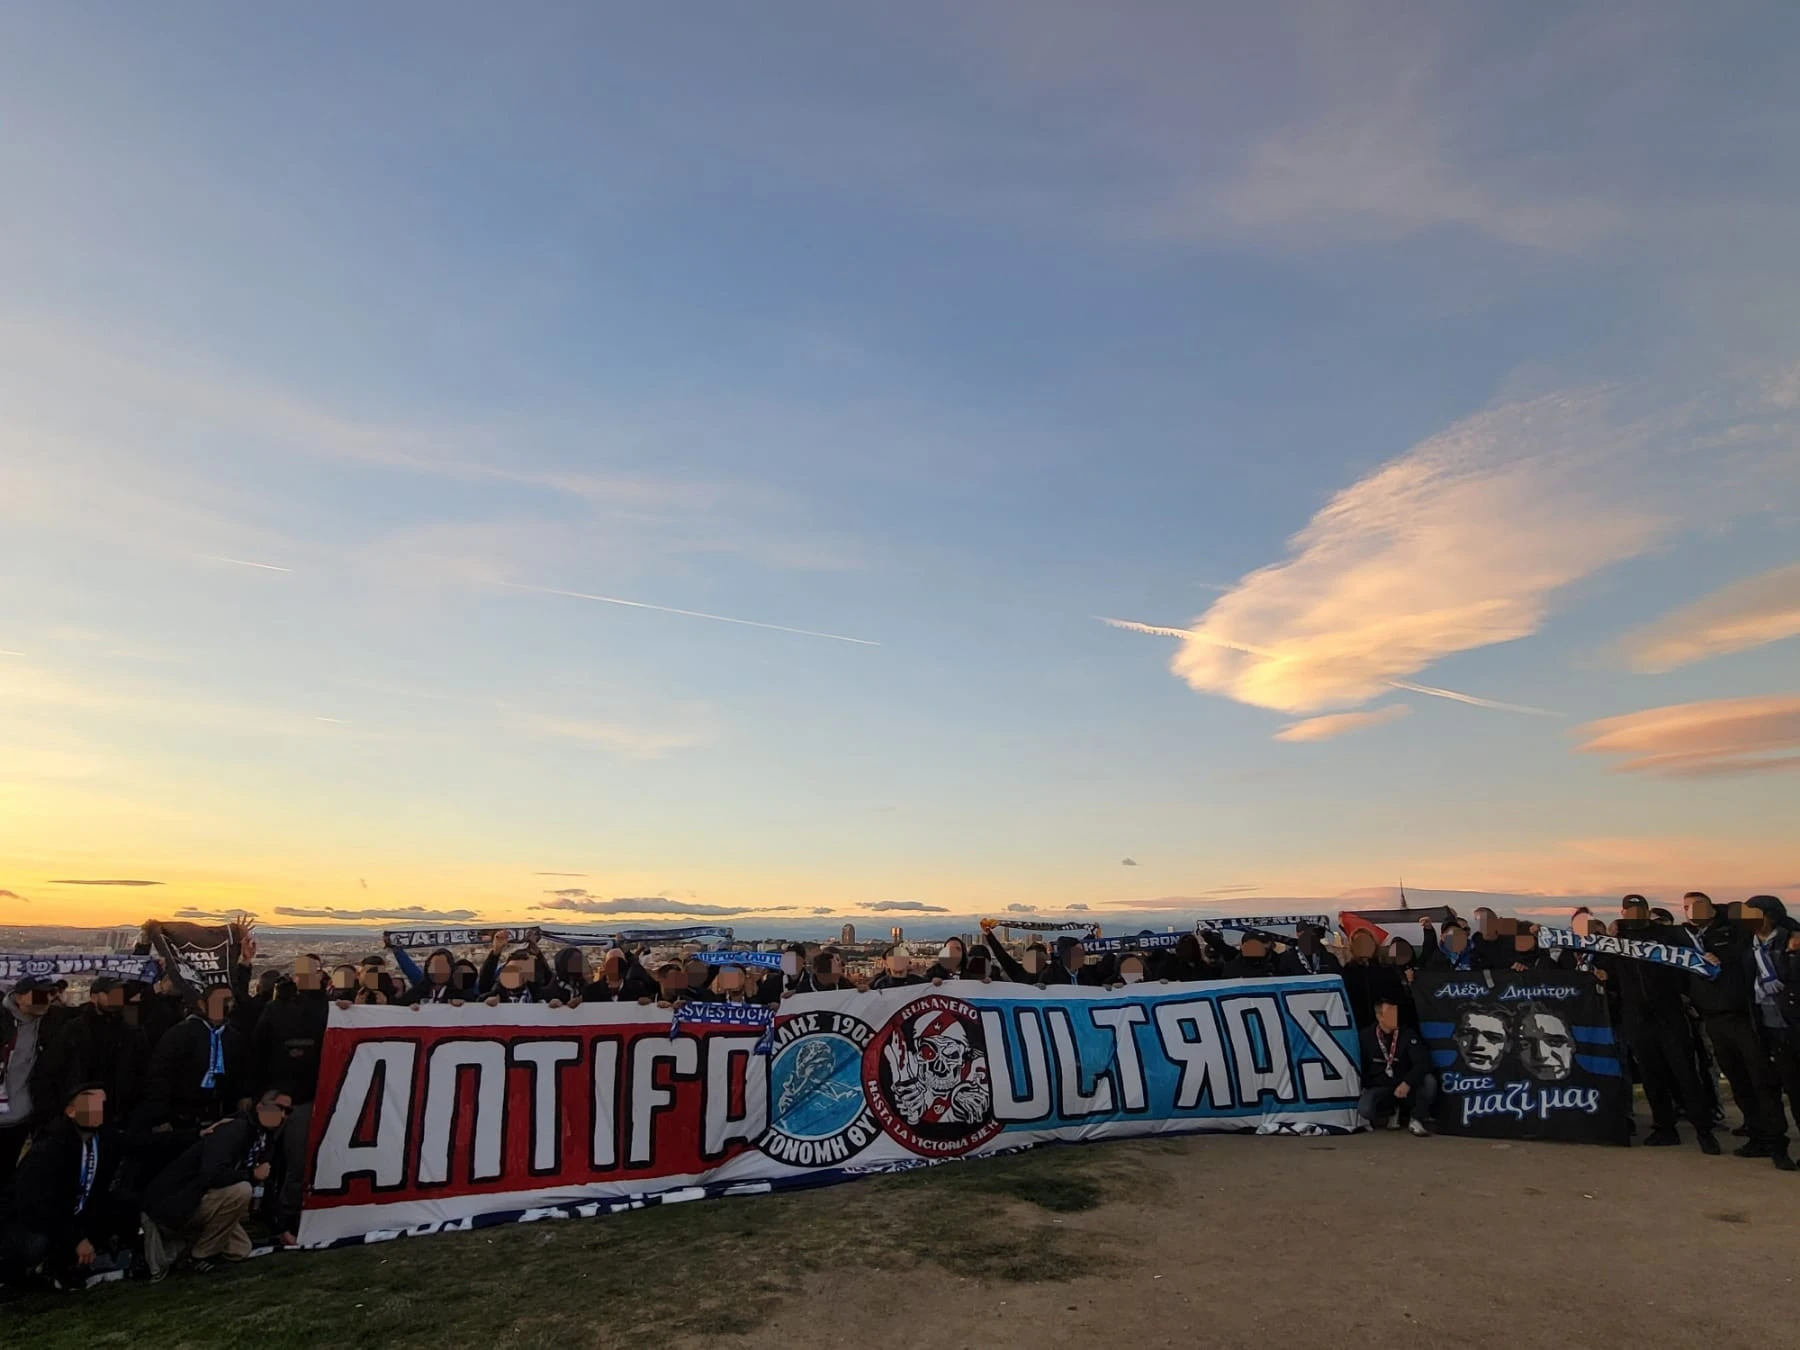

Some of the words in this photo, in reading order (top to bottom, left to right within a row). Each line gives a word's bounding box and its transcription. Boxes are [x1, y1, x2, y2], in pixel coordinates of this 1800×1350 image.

[979, 989, 1362, 1122] ULTRAS
[1463, 1082, 1535, 1125] μαζί
[1541, 1086, 1599, 1118] μας
[311, 1037, 768, 1192] ANTIFA
[867, 1080, 894, 1126] HASTA
[893, 1123, 909, 1139] LA
[911, 1135, 969, 1151] VICTORIA
